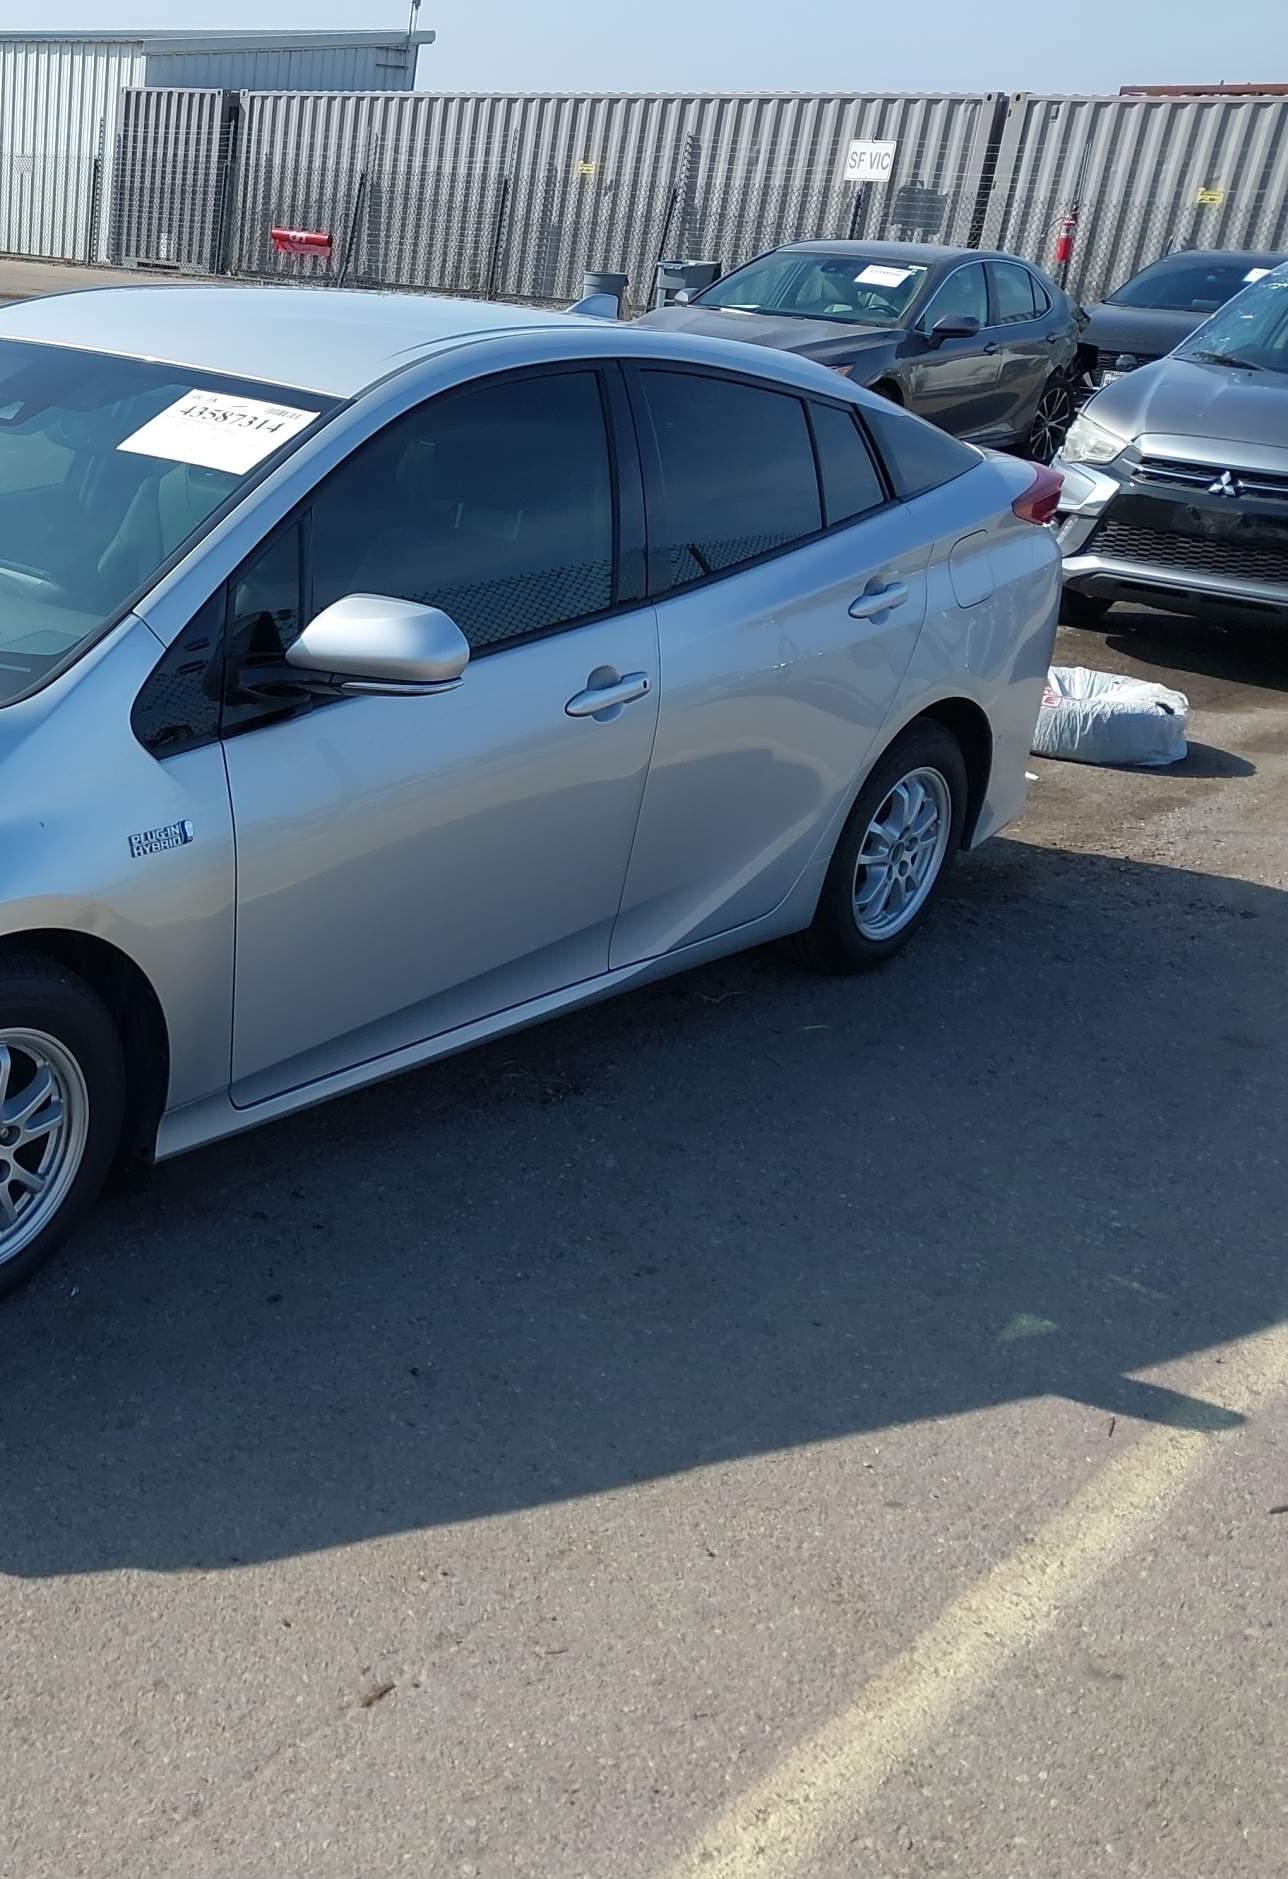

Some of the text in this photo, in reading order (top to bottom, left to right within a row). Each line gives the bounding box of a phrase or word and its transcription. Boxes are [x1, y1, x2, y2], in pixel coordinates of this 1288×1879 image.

[848, 151, 891, 170] SF VIC
[180, 405, 286, 433] 43587314
[133, 836, 182, 857] HYBRID
